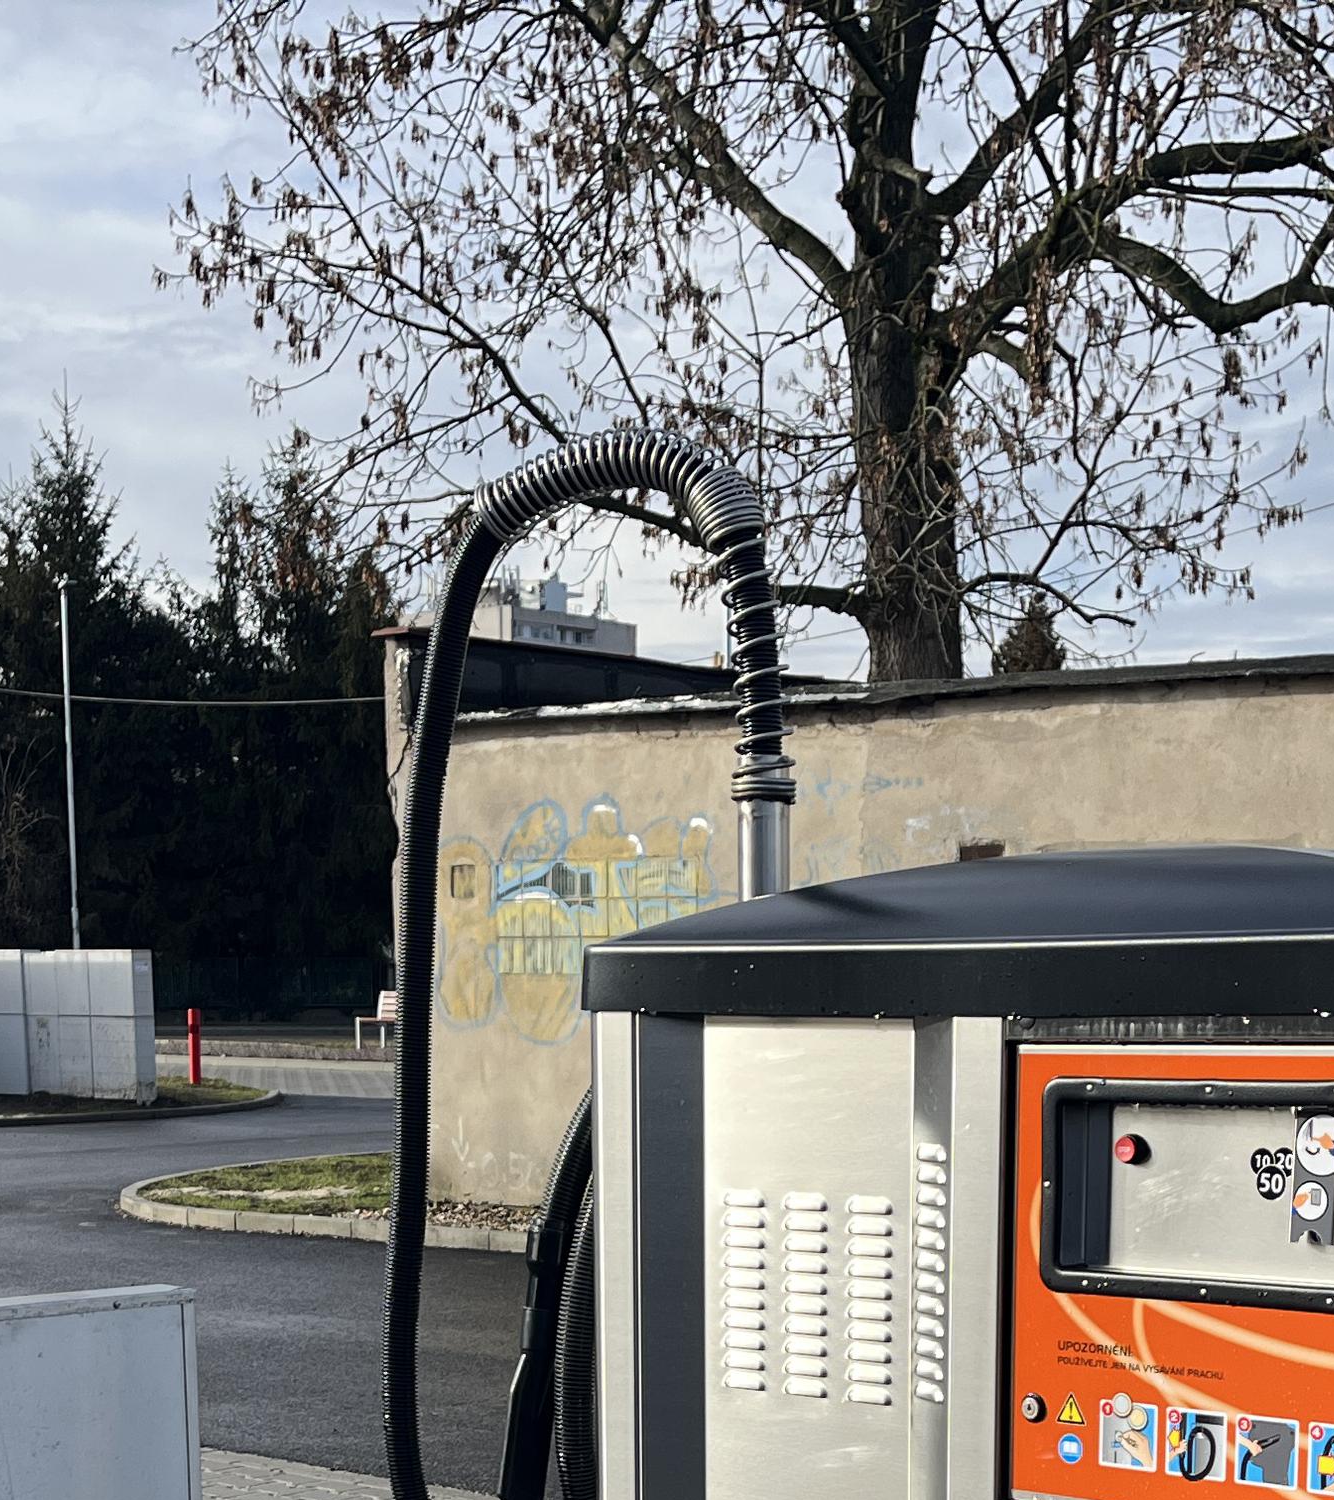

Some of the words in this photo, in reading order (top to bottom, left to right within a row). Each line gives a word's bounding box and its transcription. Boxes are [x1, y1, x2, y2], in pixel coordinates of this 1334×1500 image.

[1255, 1154, 1271, 1168] 10
[1276, 1152, 1293, 1169] 20
[1258, 1172, 1283, 1194] 50
[1110, 1361, 1127, 1371] JEN
[1128, 1363, 1141, 1373] NA
